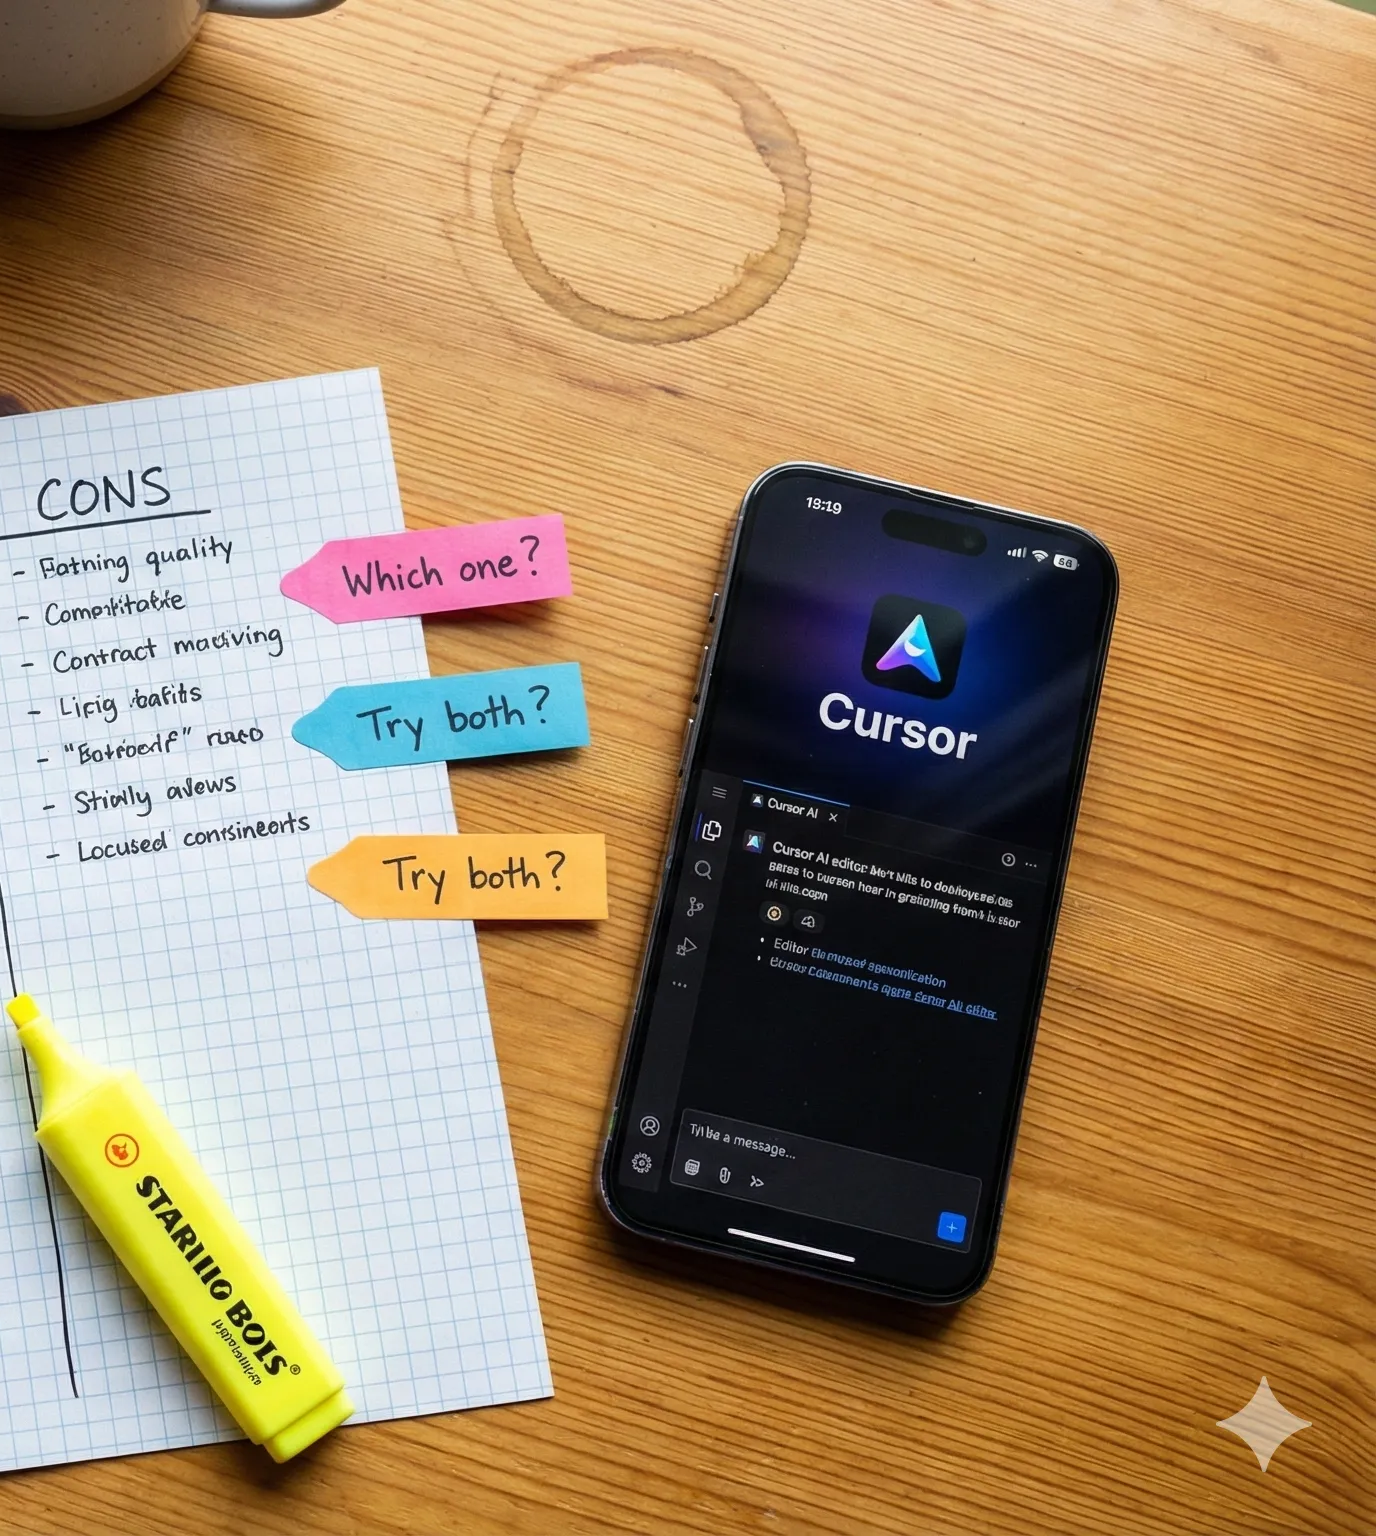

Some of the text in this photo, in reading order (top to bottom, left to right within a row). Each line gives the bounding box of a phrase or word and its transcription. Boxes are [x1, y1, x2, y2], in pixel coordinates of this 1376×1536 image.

[37, 466, 172, 521] CONS
[146, 535, 233, 576] quality
[342, 535, 540, 597] Which one?
[53, 638, 157, 673] Contract
[356, 684, 550, 751] Try both?
[819, 692, 978, 760] Cursor
[767, 797, 805, 816] Cursor
[382, 850, 566, 905] Try both?
[772, 841, 815, 863] Cursor
[816, 851, 830, 867] AI
[774, 937, 810, 957] Editor
